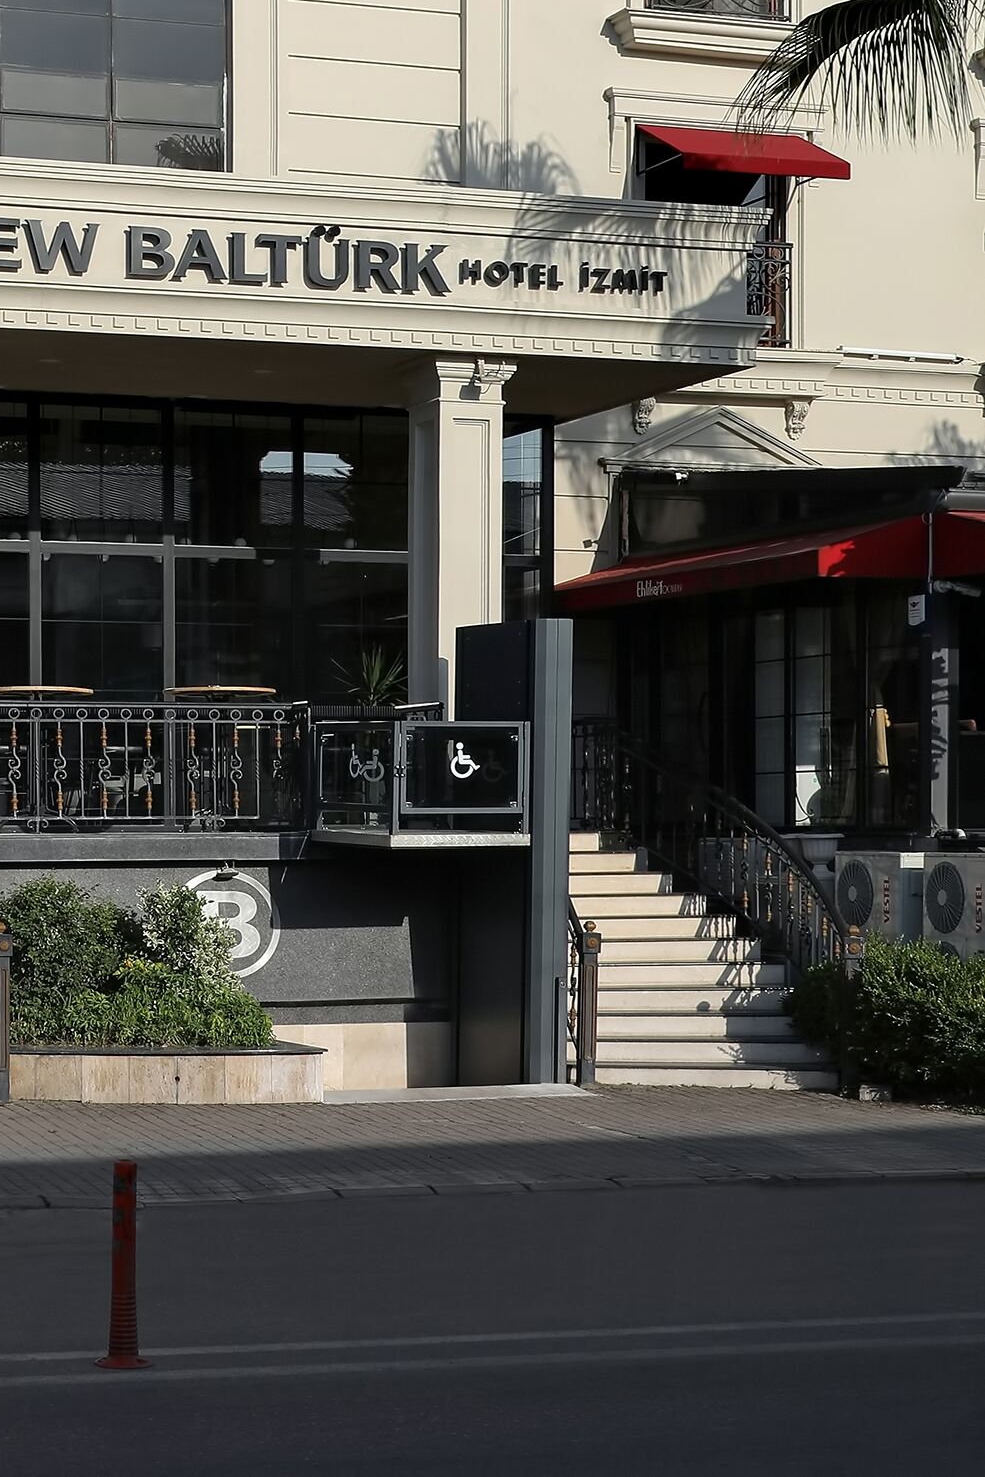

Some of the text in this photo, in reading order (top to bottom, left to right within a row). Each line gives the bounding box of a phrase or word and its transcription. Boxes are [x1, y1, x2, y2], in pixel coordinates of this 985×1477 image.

[124, 224, 452, 297] BALTÜRK
[458, 259, 564, 291] HOTEL
[578, 261, 668, 296] İZMİT
[883, 876, 891, 924] VESTEL
[975, 883, 983, 934] VESTEL
